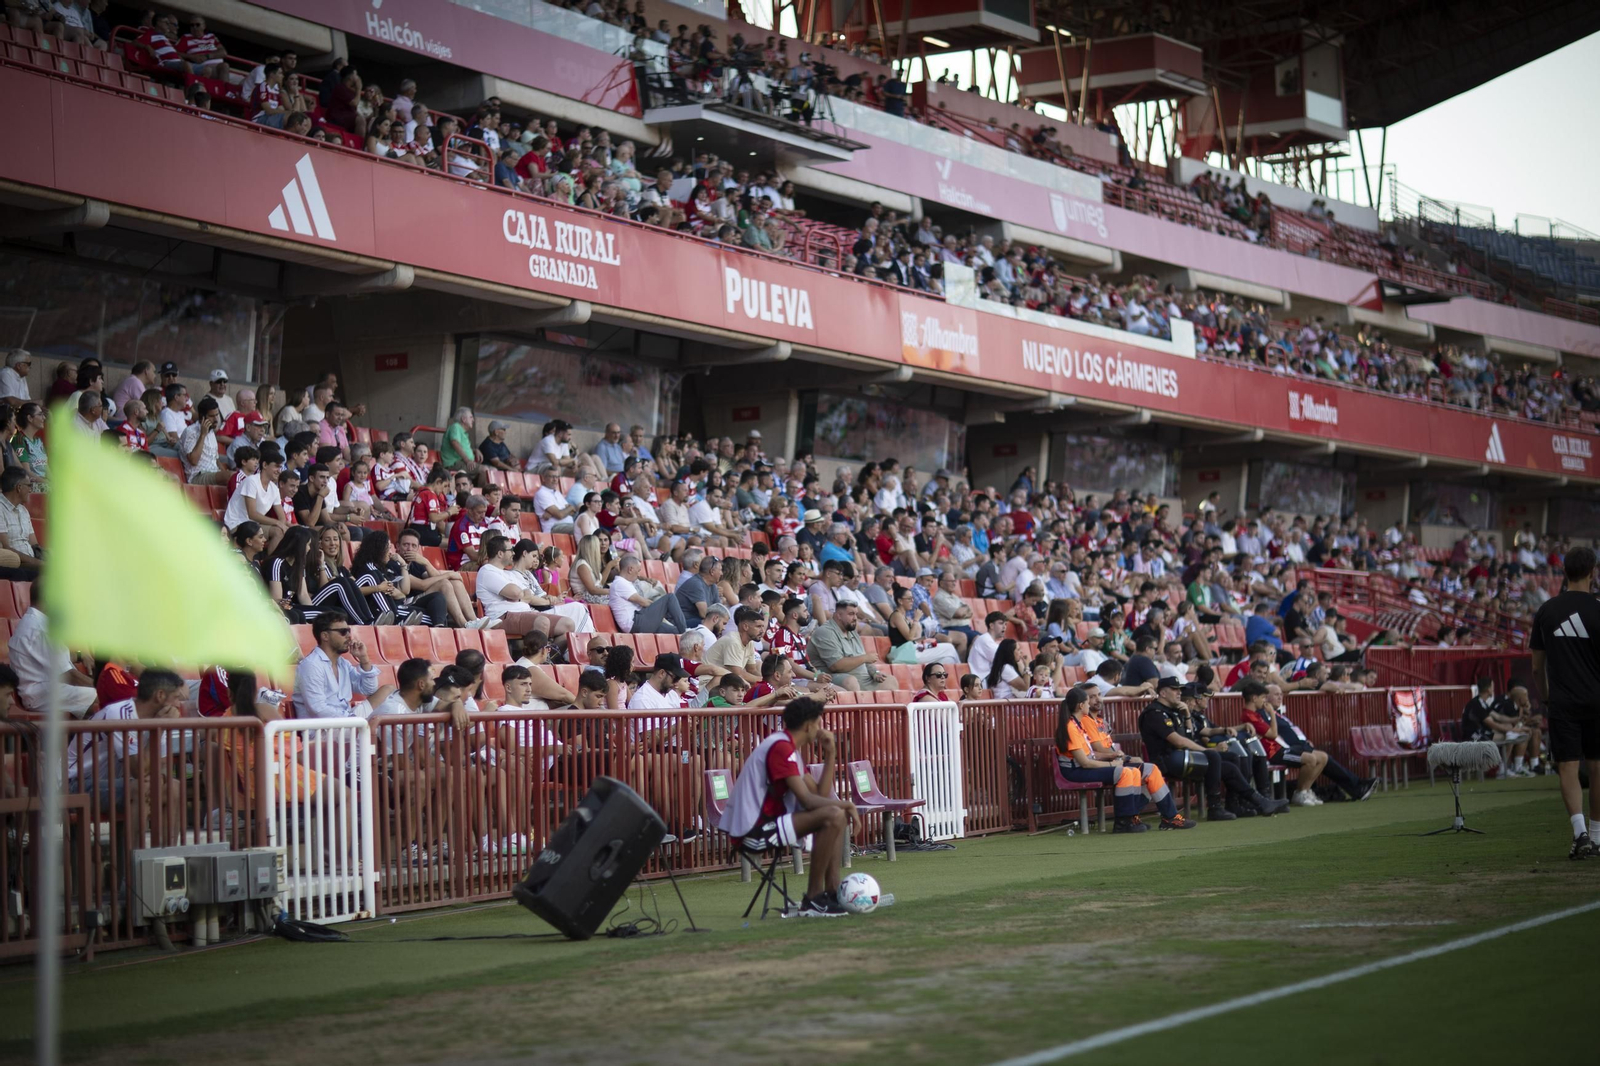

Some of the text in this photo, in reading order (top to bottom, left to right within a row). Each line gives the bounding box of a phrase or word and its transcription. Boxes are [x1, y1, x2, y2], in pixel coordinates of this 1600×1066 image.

[365, 11, 453, 58] Halcón viajes
[502, 209, 621, 266] CAJA RURAL
[529, 253, 598, 290] GRANADA
[725, 266, 814, 330] PULEVA
[1021, 339, 1179, 398] NUEVO LOS CÁRMENES
